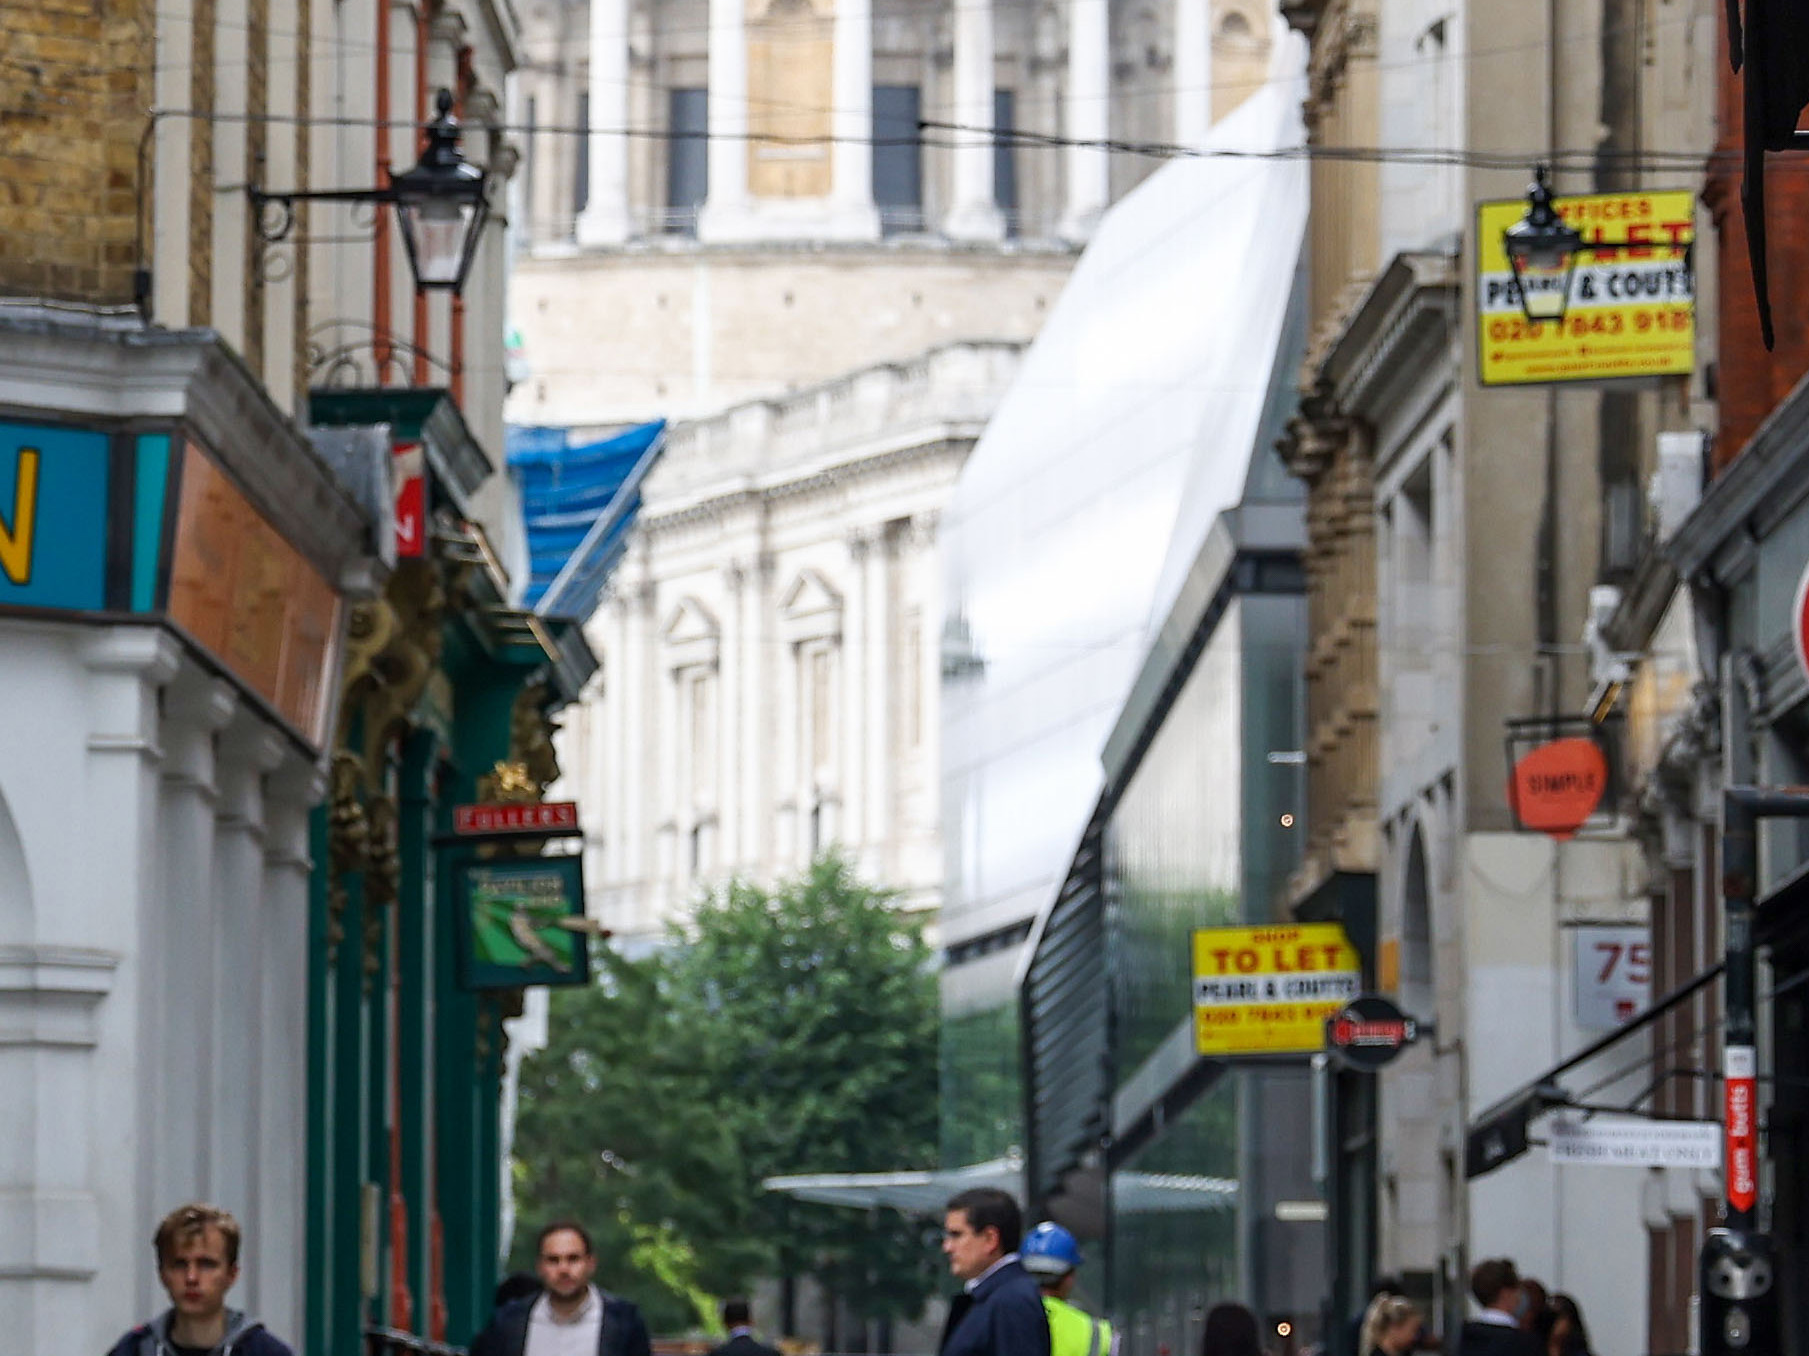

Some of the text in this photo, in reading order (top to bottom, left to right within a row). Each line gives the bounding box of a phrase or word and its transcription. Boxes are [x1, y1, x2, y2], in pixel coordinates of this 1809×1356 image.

[1594, 221, 1693, 260] LET
[1525, 770, 1598, 797] SIMPLE
[1211, 946, 1342, 976] TO LET
[1592, 941, 1652, 985] 75
[1728, 1083, 1755, 1194] gum butts
